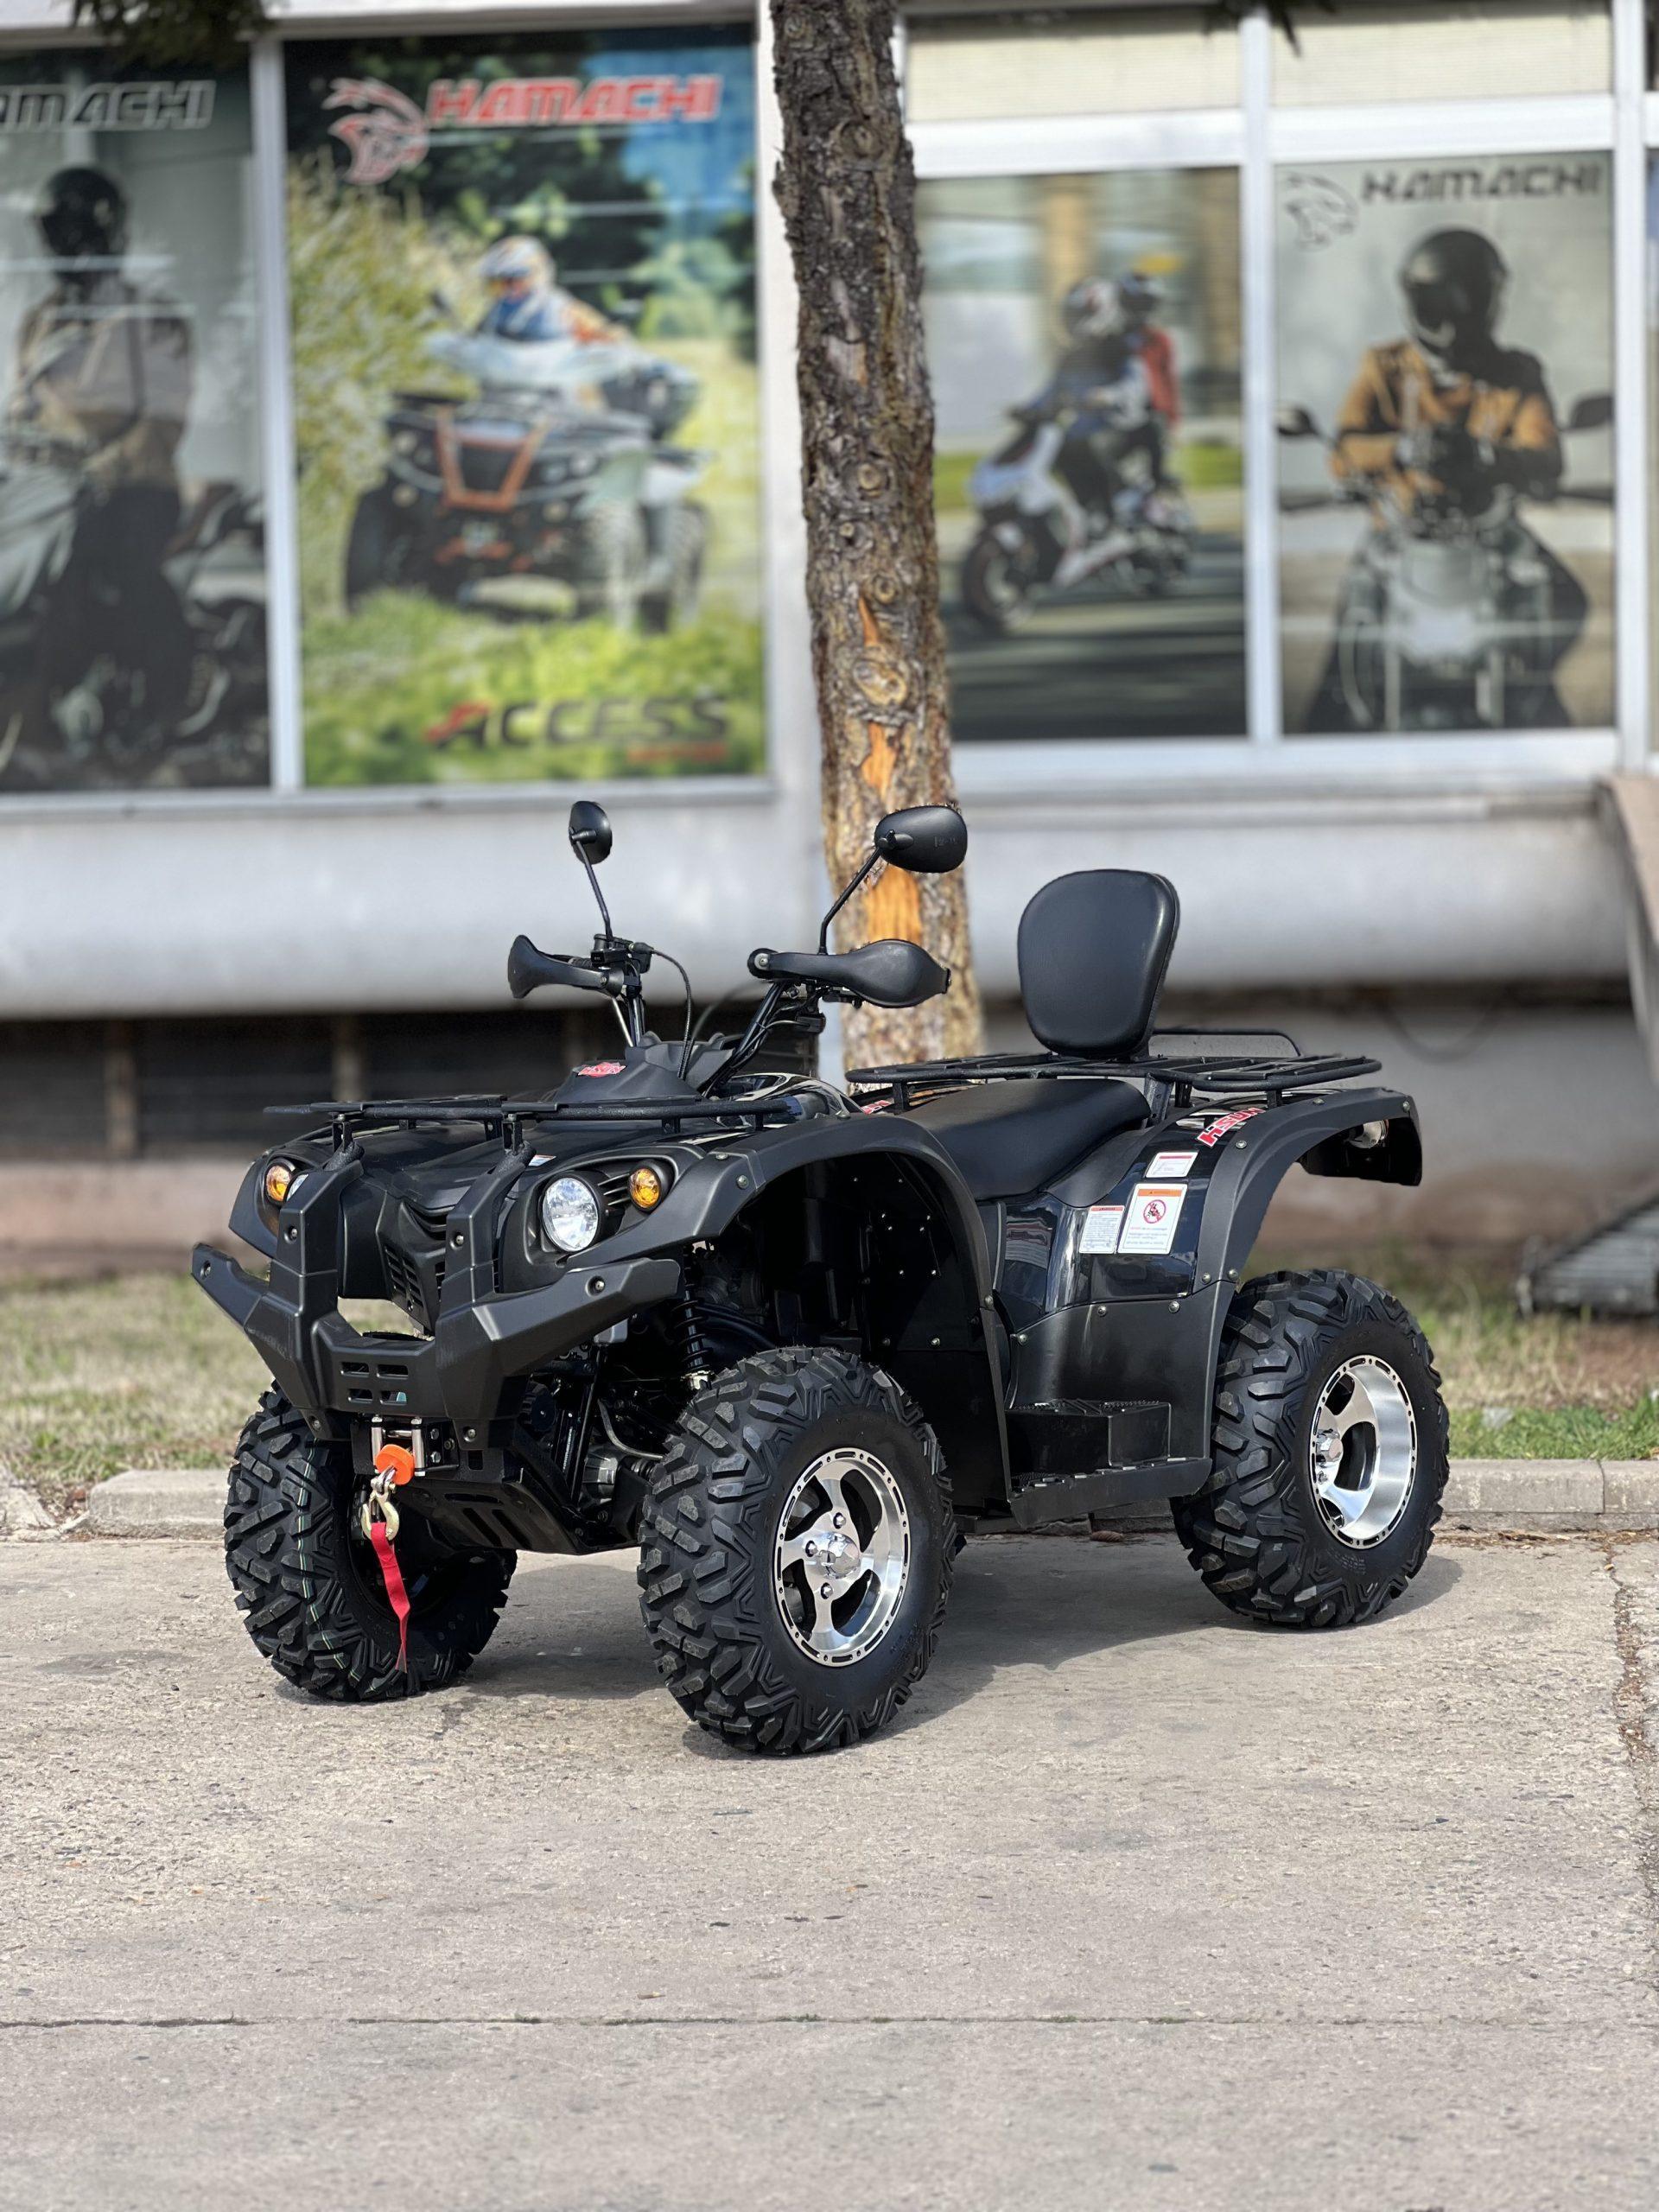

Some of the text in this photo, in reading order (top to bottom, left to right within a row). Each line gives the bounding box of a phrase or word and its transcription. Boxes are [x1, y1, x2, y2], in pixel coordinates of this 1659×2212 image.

[0, 80, 216, 131] MACHI
[427, 74, 721, 127] HAMACHI
[1363, 164, 1600, 204] HAMACHI
[426, 697, 728, 749] ACCESS
